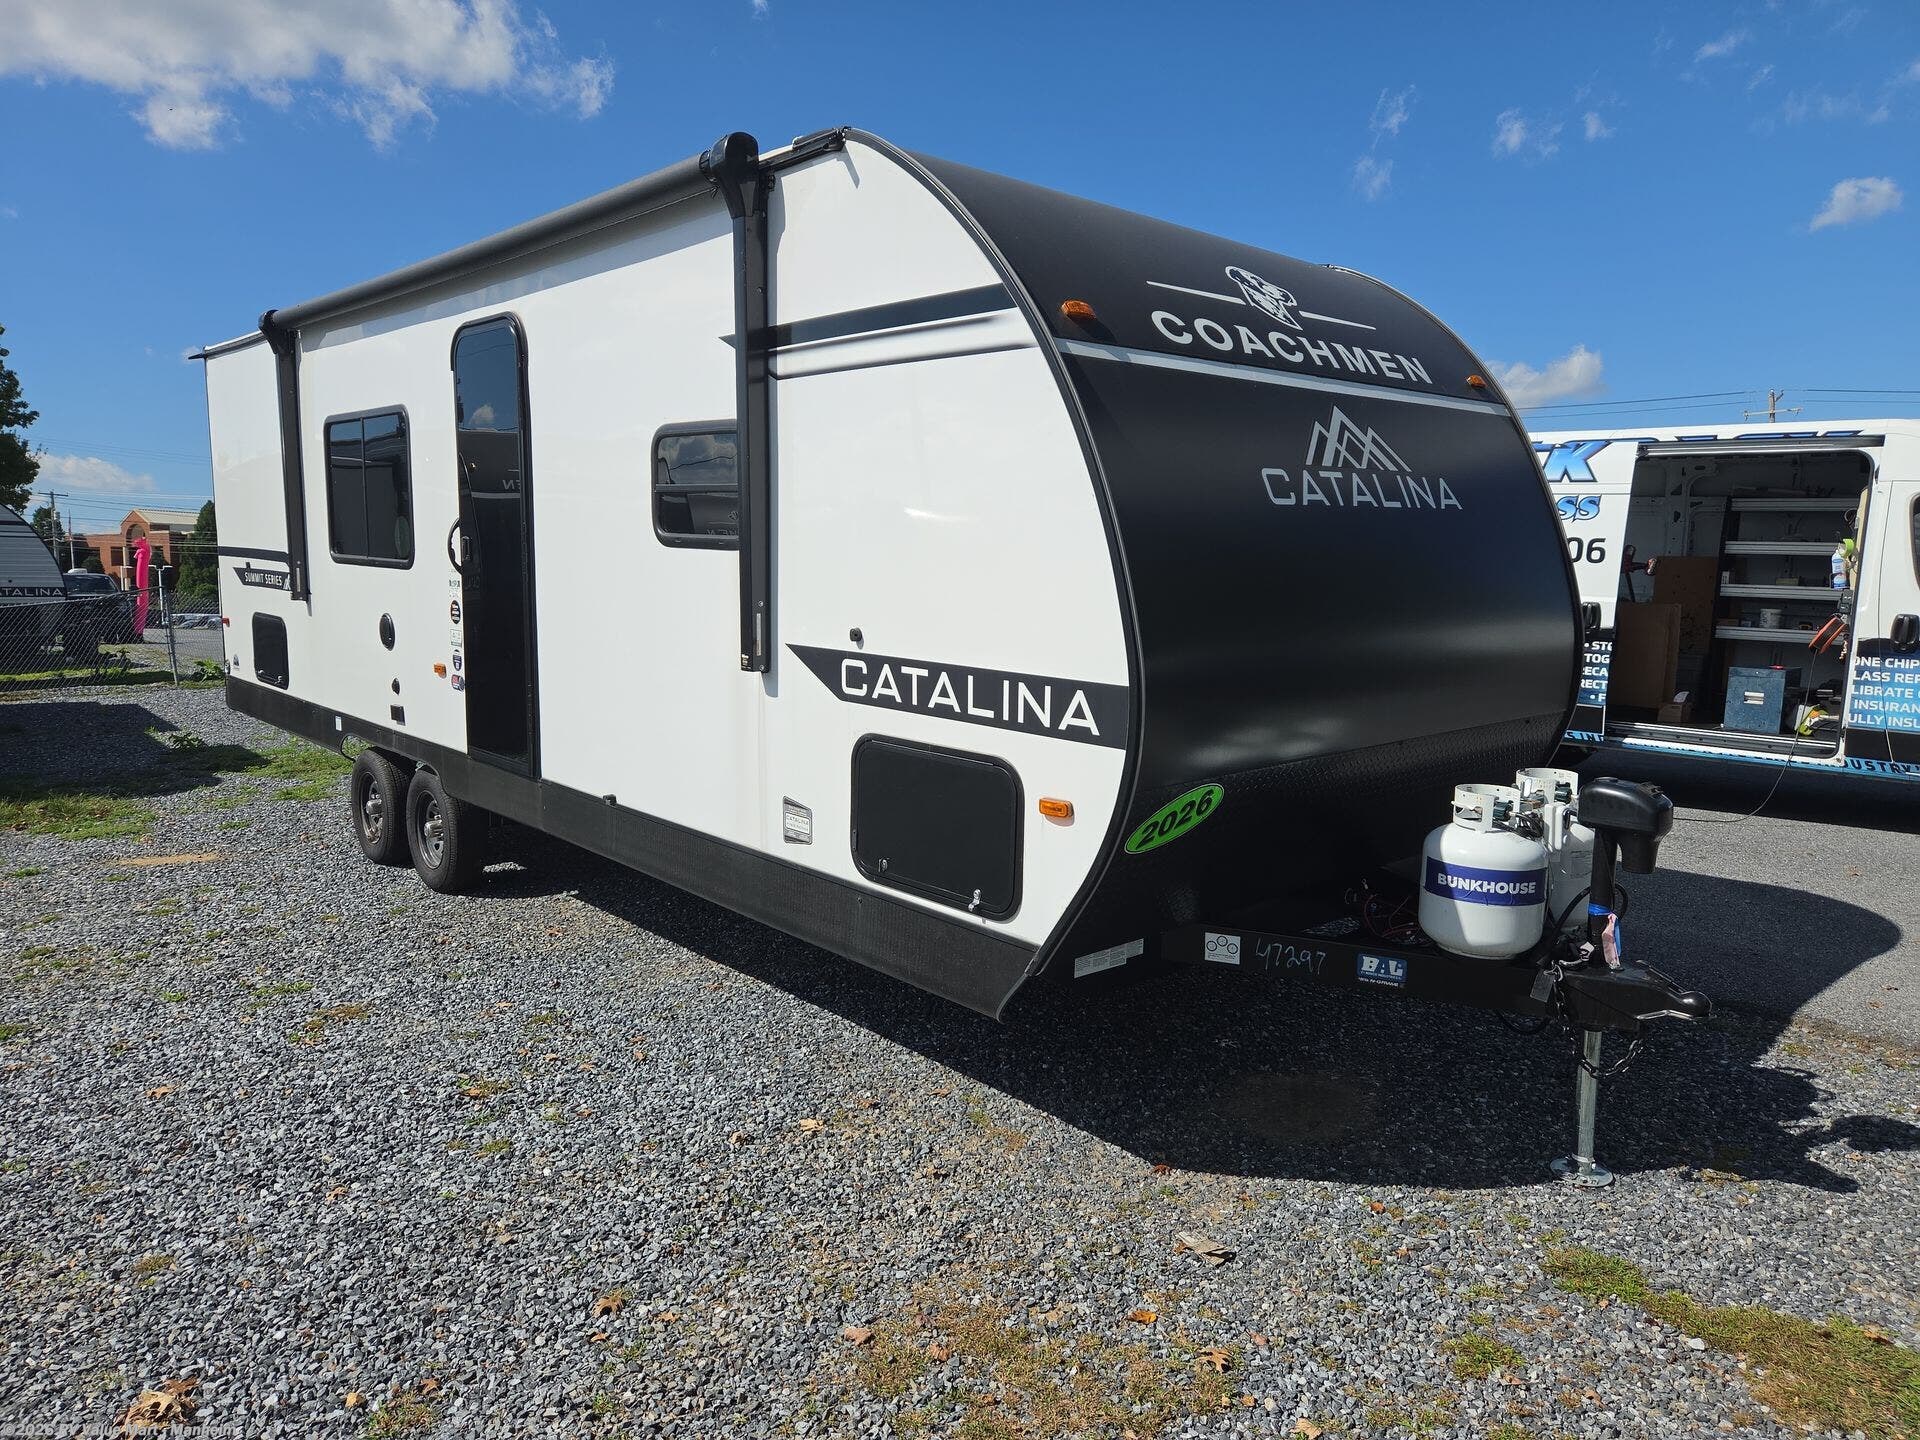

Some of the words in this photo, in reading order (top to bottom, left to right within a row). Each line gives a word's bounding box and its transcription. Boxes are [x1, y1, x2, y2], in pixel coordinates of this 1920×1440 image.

[1150, 310, 1433, 384] COACHMEN
[1261, 467, 1463, 510] CATALINA
[244, 571, 264, 583] SUMMIT
[265, 574, 283, 586] SERIES
[0, 588, 63, 596] TALINA
[1582, 666, 1608, 677] ECA
[1885, 658, 1920, 669] CHIP
[841, 658, 1099, 736] CATALINA
[1851, 684, 1914, 699] LIBRATE
[1135, 788, 1215, 851] 2026
[1437, 872, 1537, 895] BUNKHOUSE
[1255, 937, 1326, 976] 47297
